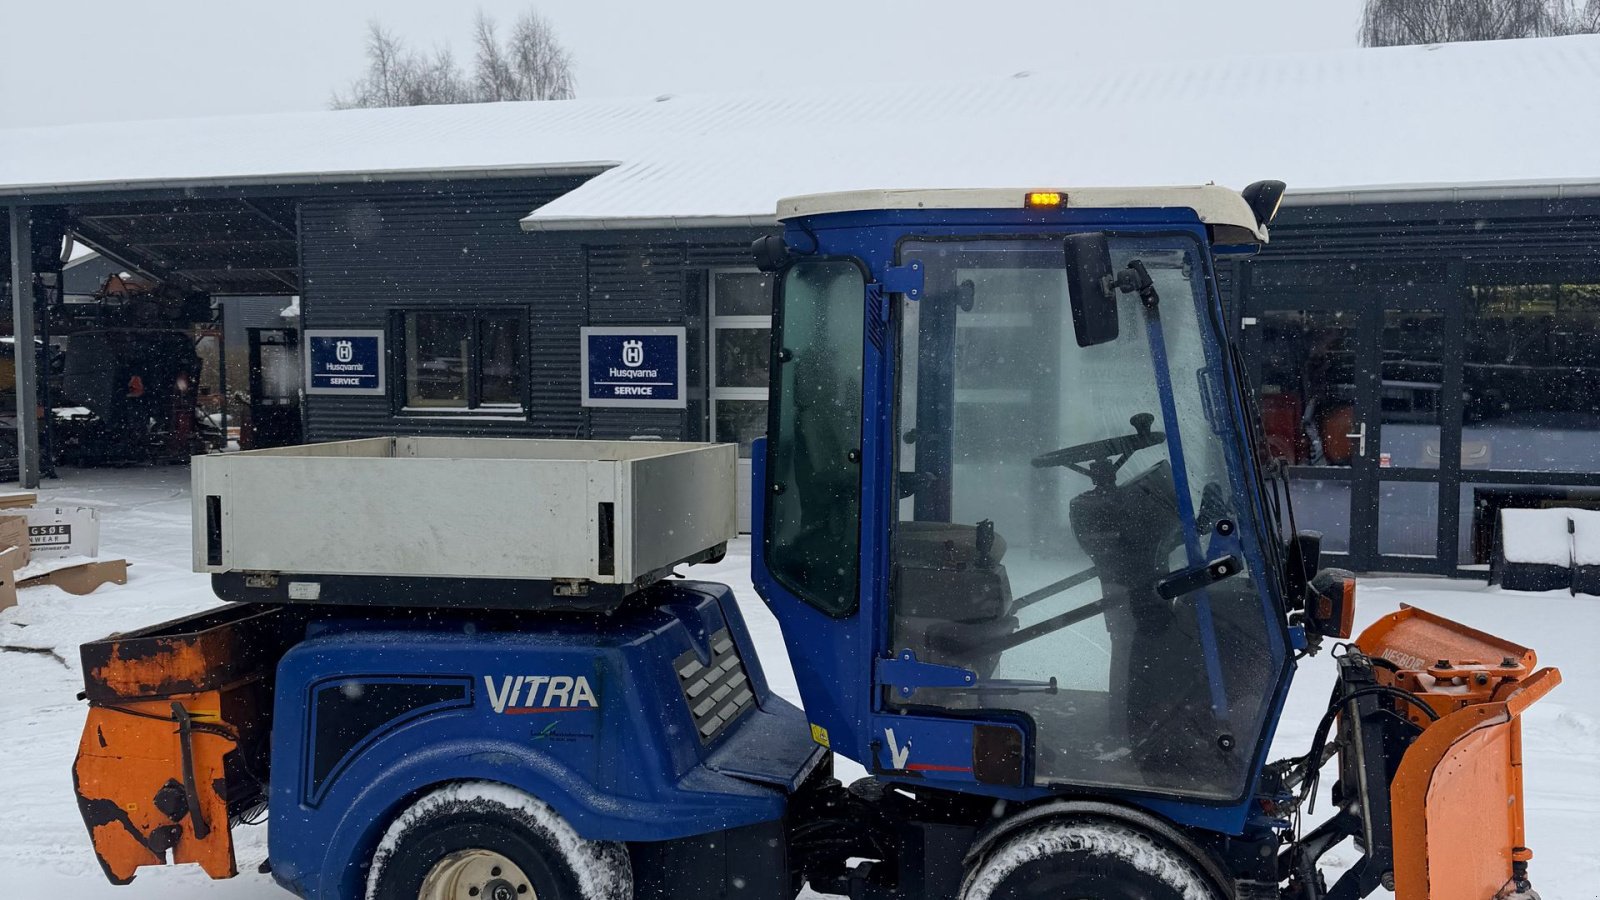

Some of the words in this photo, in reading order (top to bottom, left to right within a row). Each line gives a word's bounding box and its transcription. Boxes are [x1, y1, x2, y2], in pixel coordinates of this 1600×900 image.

[326, 362, 364, 372] Husqvarna
[609, 367, 658, 379] Husqvarna
[330, 378, 360, 386] SERVICE
[614, 386, 653, 395] SERVICE
[31, 526, 65, 535] GSØE
[484, 675, 599, 714] VITRA
